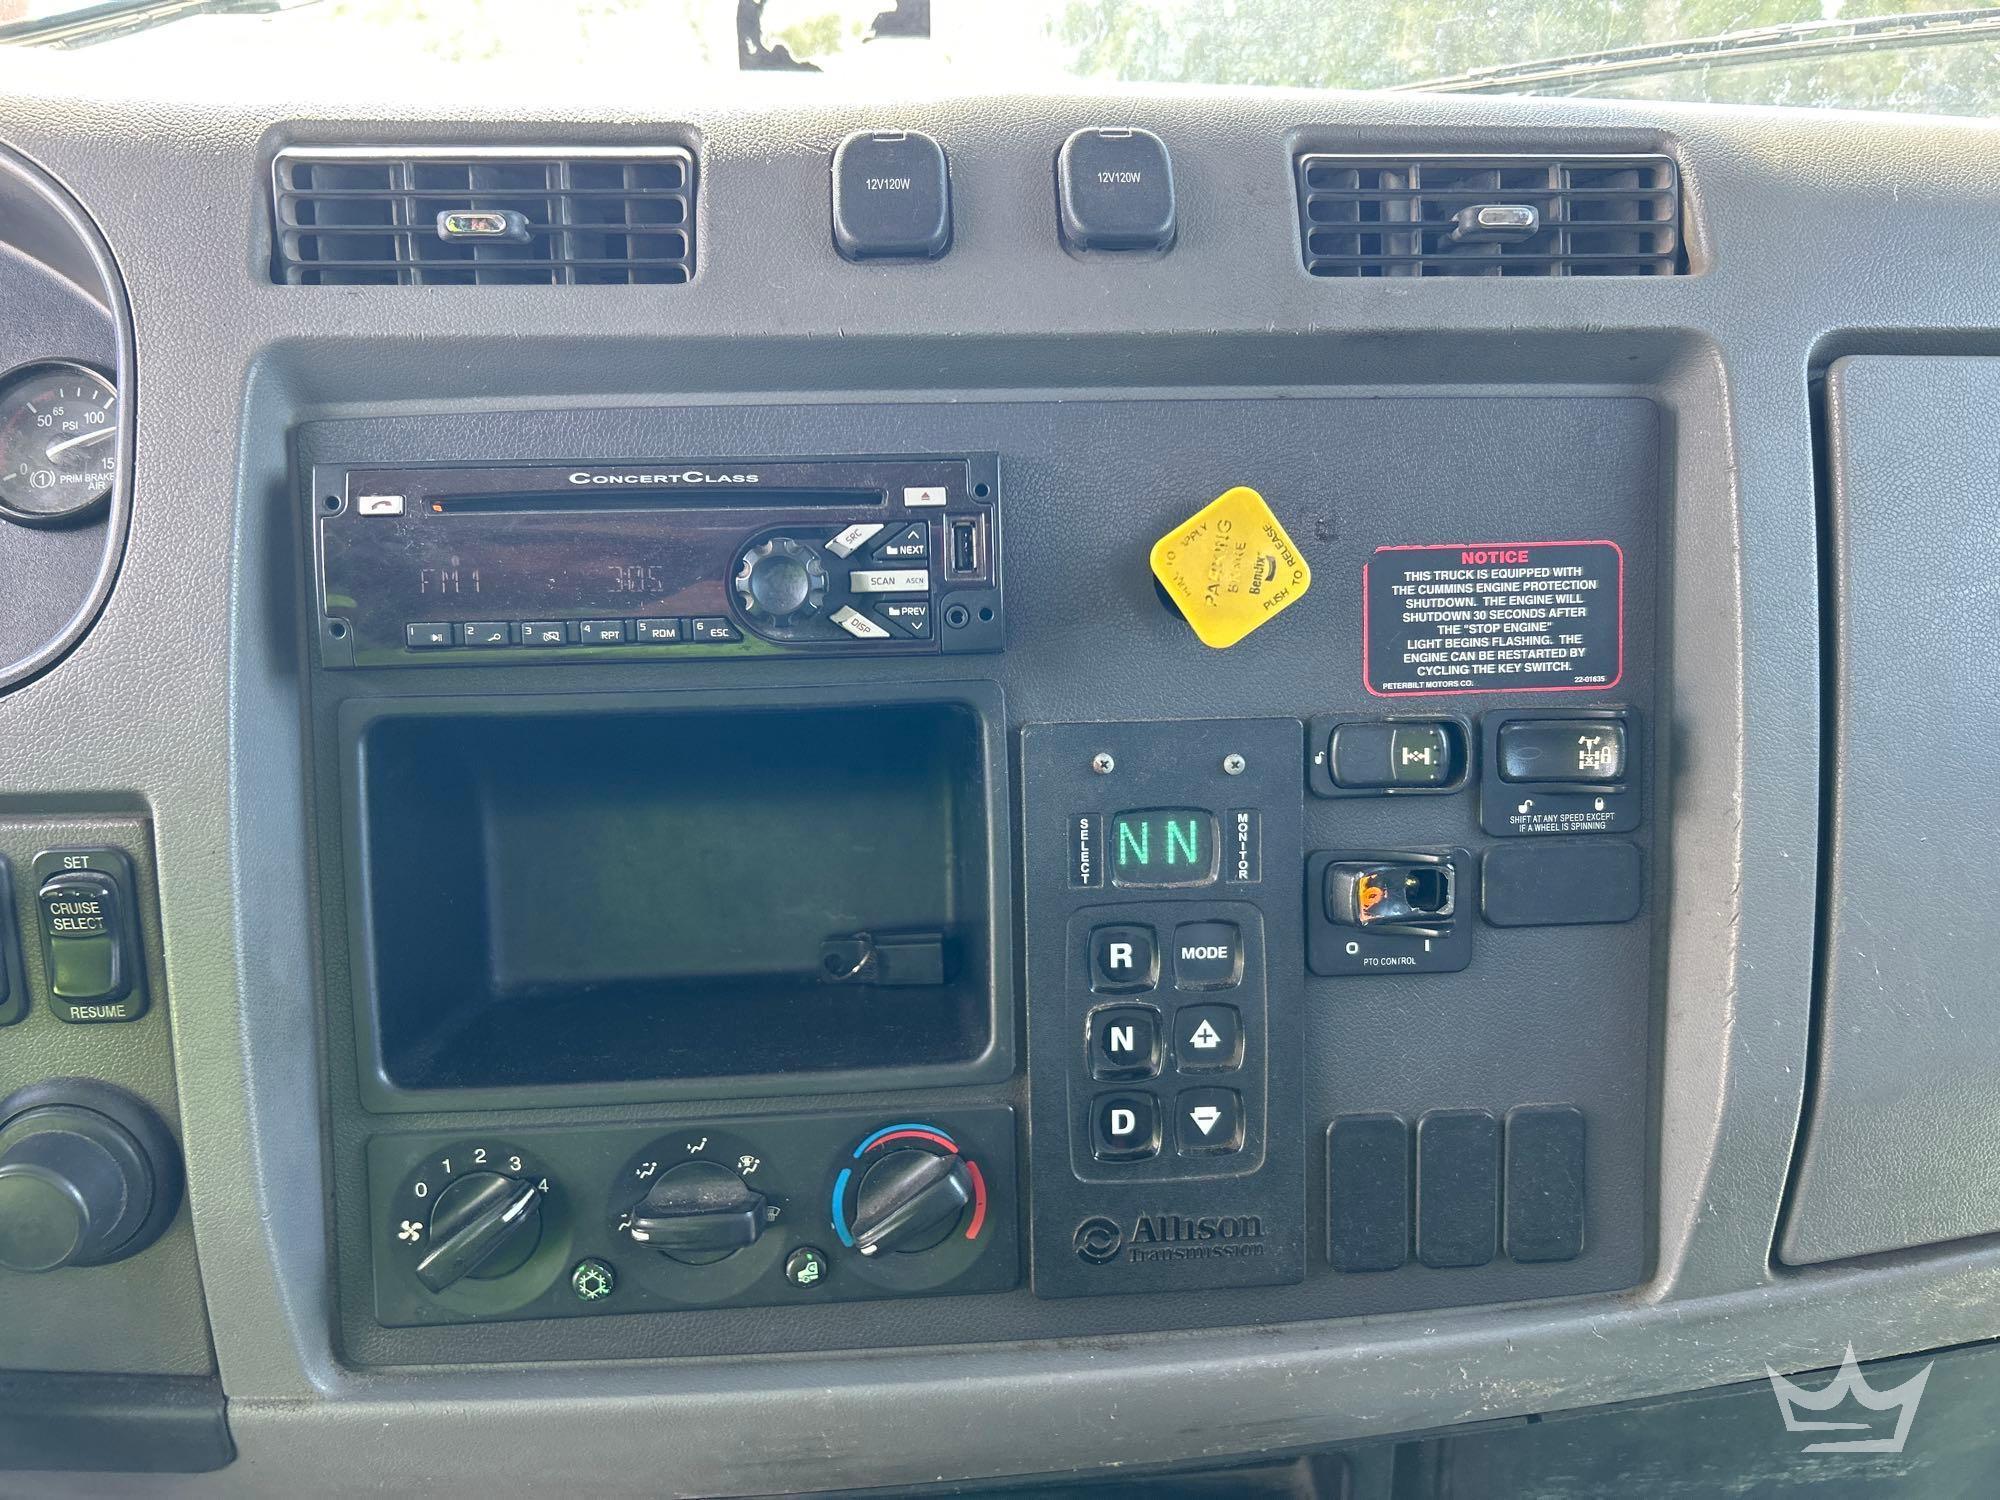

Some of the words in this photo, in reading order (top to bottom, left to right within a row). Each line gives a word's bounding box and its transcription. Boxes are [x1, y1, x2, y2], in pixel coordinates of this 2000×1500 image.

[865, 178, 911, 191] 12V120W
[1097, 172, 1142, 184] 12V120W
[52, 407, 64, 416] 65
[84, 411, 105, 424] 100
[37, 415, 53, 427] 50
[62, 421, 79, 431] PSI
[20, 463, 28, 475] 0
[60, 474, 83, 484] PRIM
[88, 481, 106, 490] AIR
[844, 528, 863, 545] SRC
[899, 545, 924, 555] NEXT
[1262, 522, 1297, 568] RELEASE
[1461, 550, 1529, 565] NOTICE
[871, 576, 896, 586] SCAN
[905, 577, 924, 585] ASCN
[1248, 554, 1266, 596] Bendix
[1291, 569, 1304, 587] TO
[1403, 570, 1431, 582] THIS
[1433, 569, 1475, 581] TRUCK
[1477, 569, 1489, 580] IS
[1491, 567, 1550, 579] EQUIPPED
[1552, 566, 1583, 577] WITH
[1392, 584, 1416, 596] THE
[1418, 583, 1473, 595] CUMMINS
[1476, 582, 1520, 593] ENGINE
[1523, 580, 1597, 592] PROTECTION
[1263, 587, 1290, 611] PUSH
[1405, 597, 1477, 609] SHUTDOWN.
[1482, 595, 1506, 607] THE
[1509, 594, 1553, 606] ENGINE
[1555, 593, 1585, 604] WILL
[901, 606, 926, 616] PREV
[1402, 611, 1470, 623] SHUTDOWN
[1473, 610, 1487, 621] 30
[1489, 608, 1546, 620] SECONDS
[1548, 606, 1587, 618] AFTER
[410, 626, 415, 636] 1
[467, 626, 474, 636] 2
[525, 626, 532, 635] 3
[583, 624, 591, 633] 4
[601, 630, 620, 640] RPT
[639, 622, 647, 632] 5
[696, 622, 704, 631] 6
[710, 628, 730, 638] ESC
[850, 617, 872, 635] DISP
[1436, 624, 1462, 635] THE
[1463, 623, 1501, 634] "STOP
[1503, 621, 1552, 633] ENGINE"
[1407, 638, 1443, 650] LIGHT
[1445, 637, 1489, 649] BEGINS
[1491, 635, 1554, 647] FLASHING.
[1558, 634, 1584, 645] THE
[1403, 652, 1448, 664] ENGINE
[1450, 651, 1476, 662] CAN
[1478, 650, 1497, 661] BE
[1497, 648, 1567, 660] RESTARTED
[1569, 647, 1586, 658] BY
[1416, 665, 1470, 677] CYCLING
[1471, 664, 1496, 675] THE
[1498, 663, 1521, 674] KEY
[1523, 661, 1573, 673] SWITCH.
[1382, 681, 1425, 690] PETERBILT
[1425, 680, 1459, 689] MOTORS
[1459, 679, 1474, 687] CO.
[1574, 675, 1606, 683] 22-01635
[1509, 815, 1532, 824] SHIFT
[1533, 814, 1543, 823] AT
[1543, 814, 1558, 823] ANY
[1560, 813, 1584, 822] SPEED
[1586, 812, 1615, 821] EXCEPT
[1519, 824, 1526, 833] IF
[1527, 824, 1533, 832] A
[1534, 823, 1560, 832] WHEEL
[1561, 822, 1569, 831] IS
[1570, 821, 1606, 831] SPINNING
[1119, 821, 1149, 865] N
[1167, 820, 1197, 864] N
[1237, 813, 1249, 880] MONITOR
[1079, 818, 1090, 884] SELECT
[63, 855, 90, 869] SET
[49, 901, 101, 915] CRUISE
[53, 916, 104, 931] SELECT
[1109, 942, 1133, 969] R
[1181, 946, 1228, 960] MODE
[1363, 957, 1379, 967] PTO
[1380, 956, 1417, 966] CONTROL
[70, 1004, 126, 1019] RESUME
[1110, 1025, 1135, 1052] N
[1110, 1108, 1136, 1135] D
[473, 1148, 487, 1164] 2
[509, 1155, 523, 1171] 3
[441, 1157, 451, 1174] 1
[414, 1181, 428, 1198] 0
[538, 1178, 550, 1193] 4
[1128, 1211, 1266, 1244] Allison
[1128, 1242, 1265, 1262] Transmission
